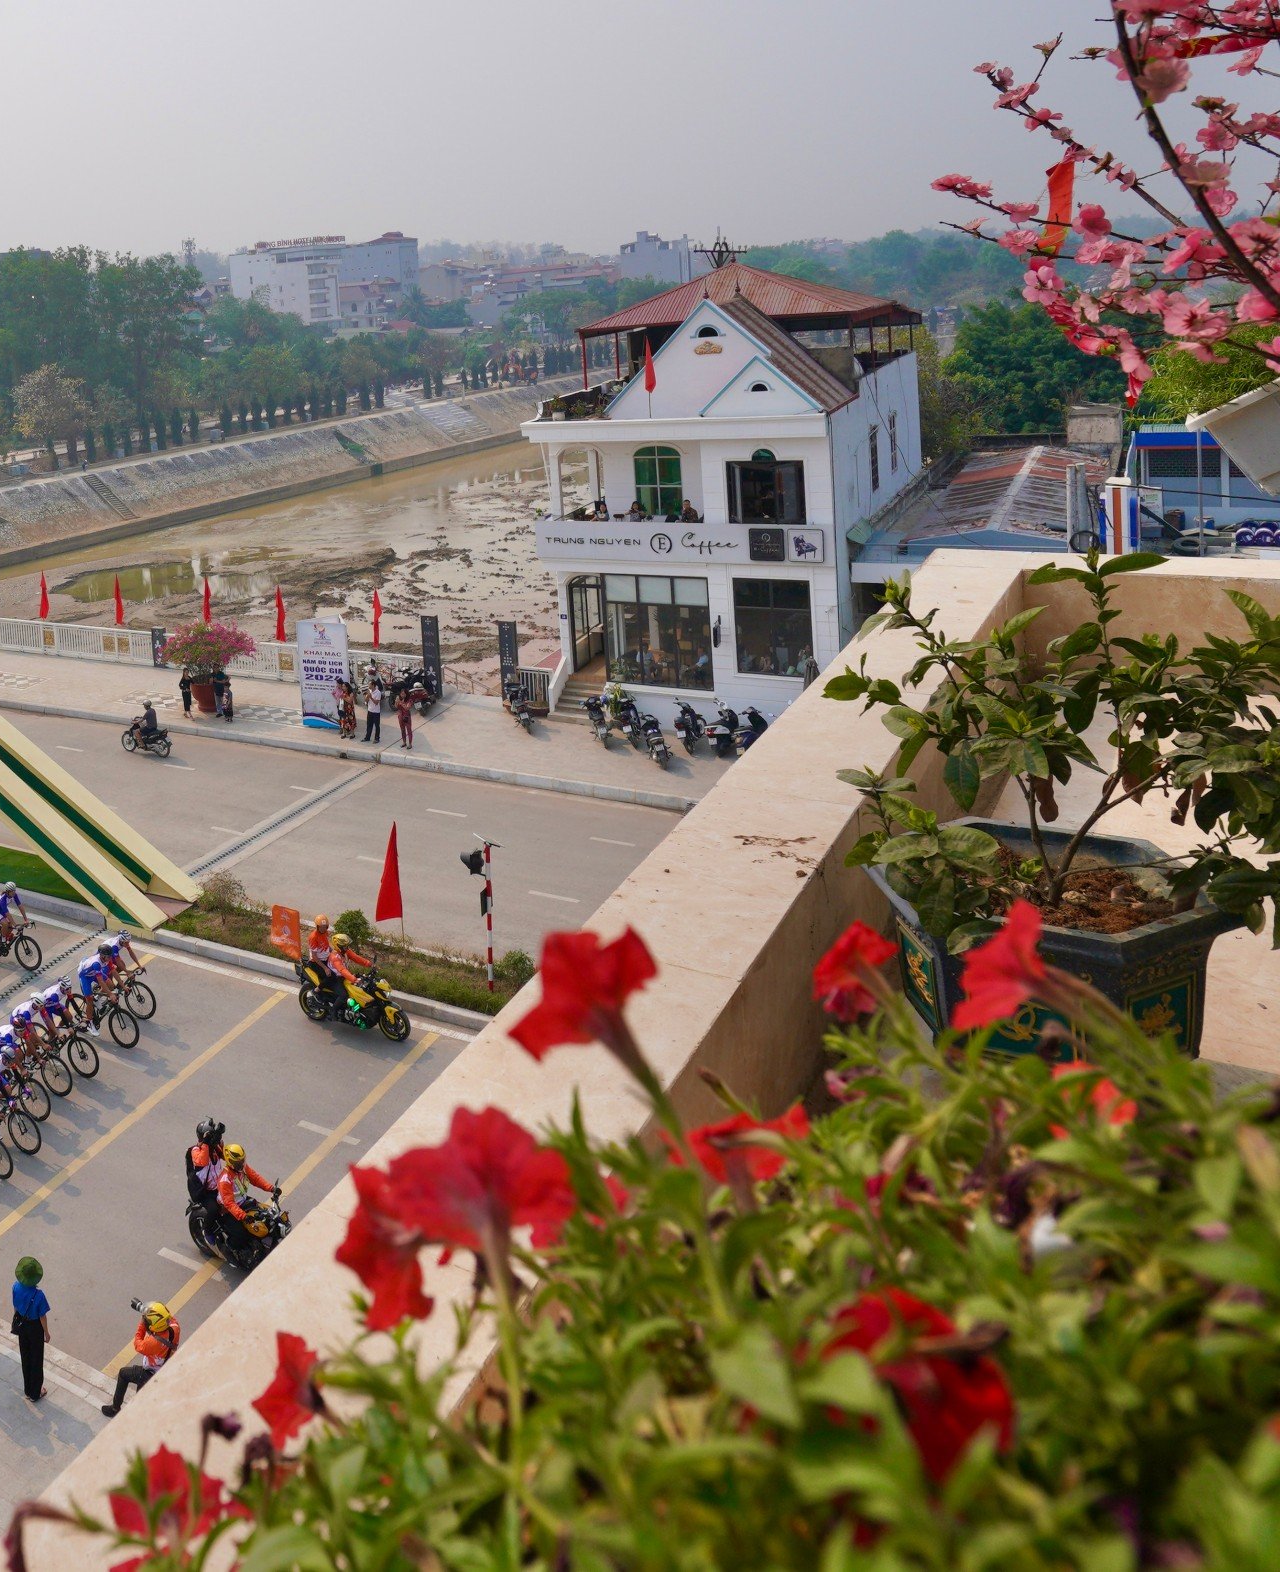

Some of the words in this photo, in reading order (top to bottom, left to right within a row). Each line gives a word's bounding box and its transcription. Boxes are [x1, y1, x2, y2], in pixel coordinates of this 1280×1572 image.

[545, 537, 585, 545] TRUNG
[681, 531, 739, 555] Coffee
[329, 667, 344, 675] GIA
